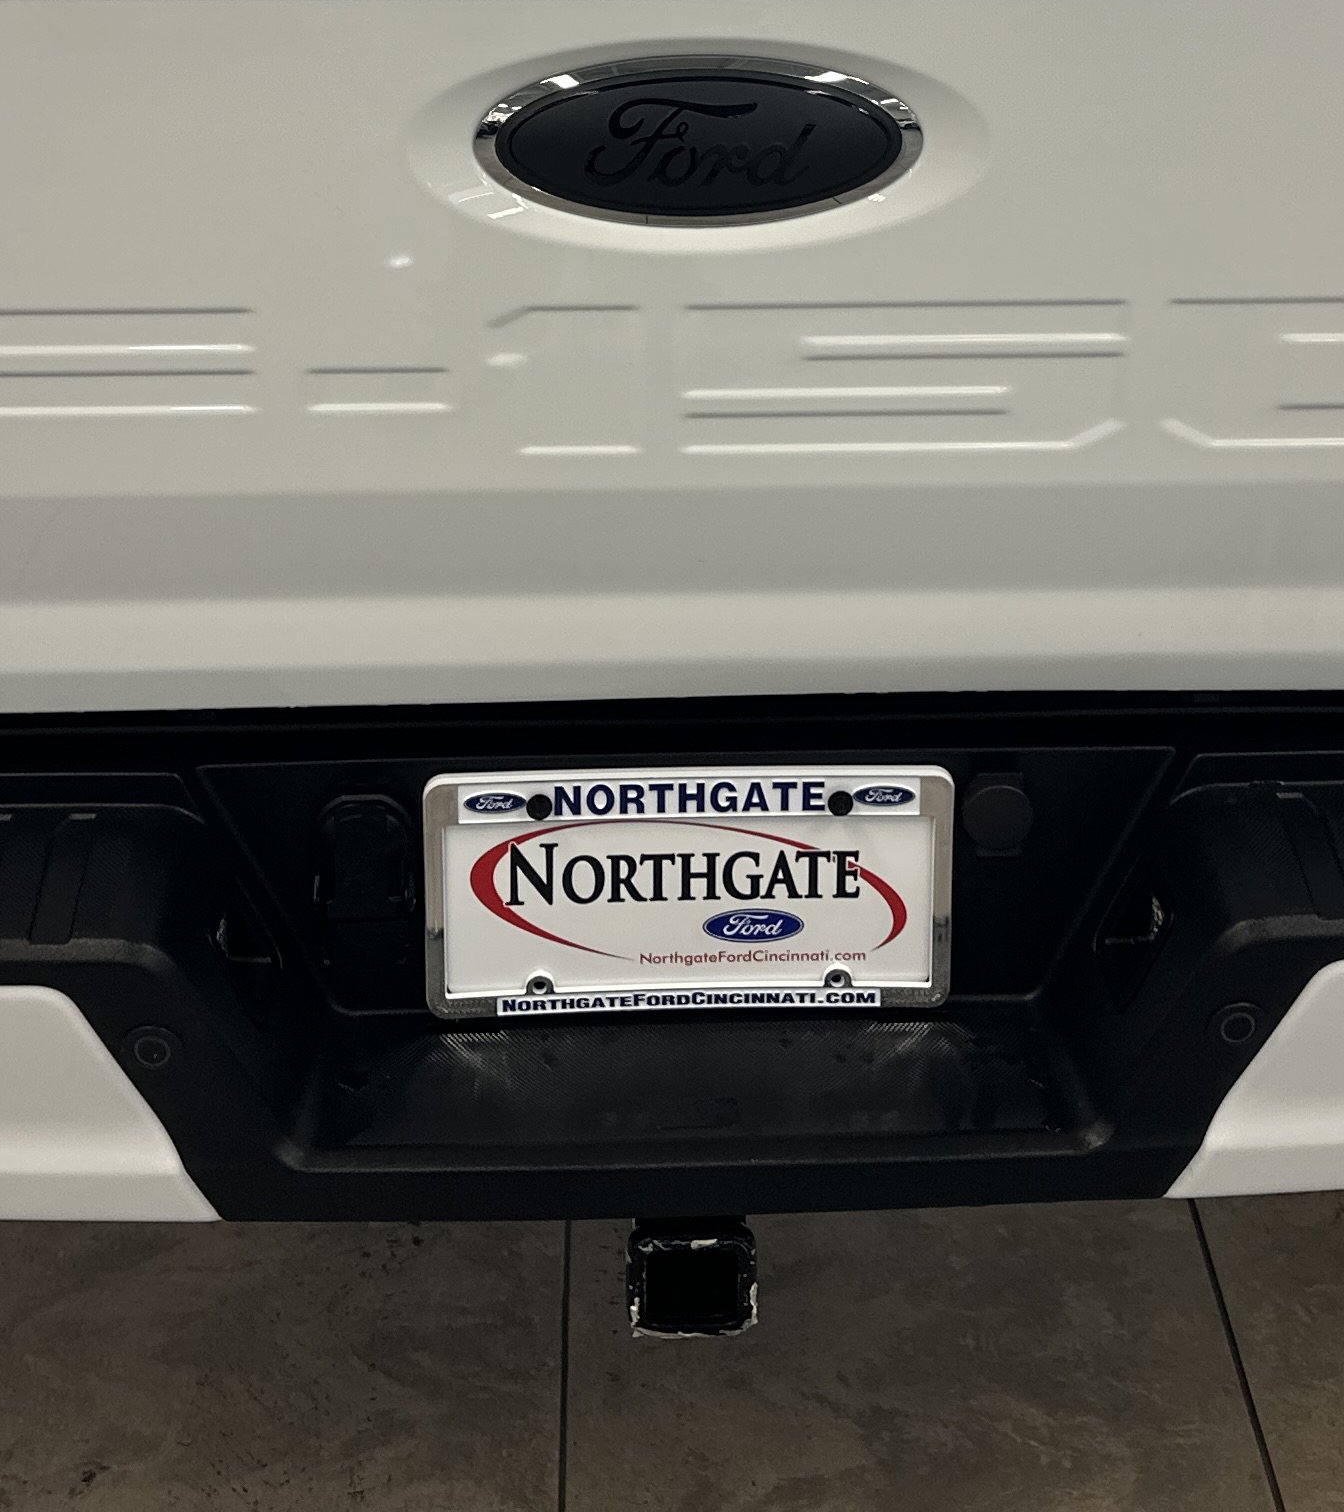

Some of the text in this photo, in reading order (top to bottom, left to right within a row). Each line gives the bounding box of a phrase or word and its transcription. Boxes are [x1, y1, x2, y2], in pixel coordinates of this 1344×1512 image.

[583, 97, 816, 188] Ford
[473, 781, 903, 817] Ford NORTHGATE Ford
[722, 910, 785, 937] Ford
[639, 949, 867, 967] NorthgateFordCincinnati.com
